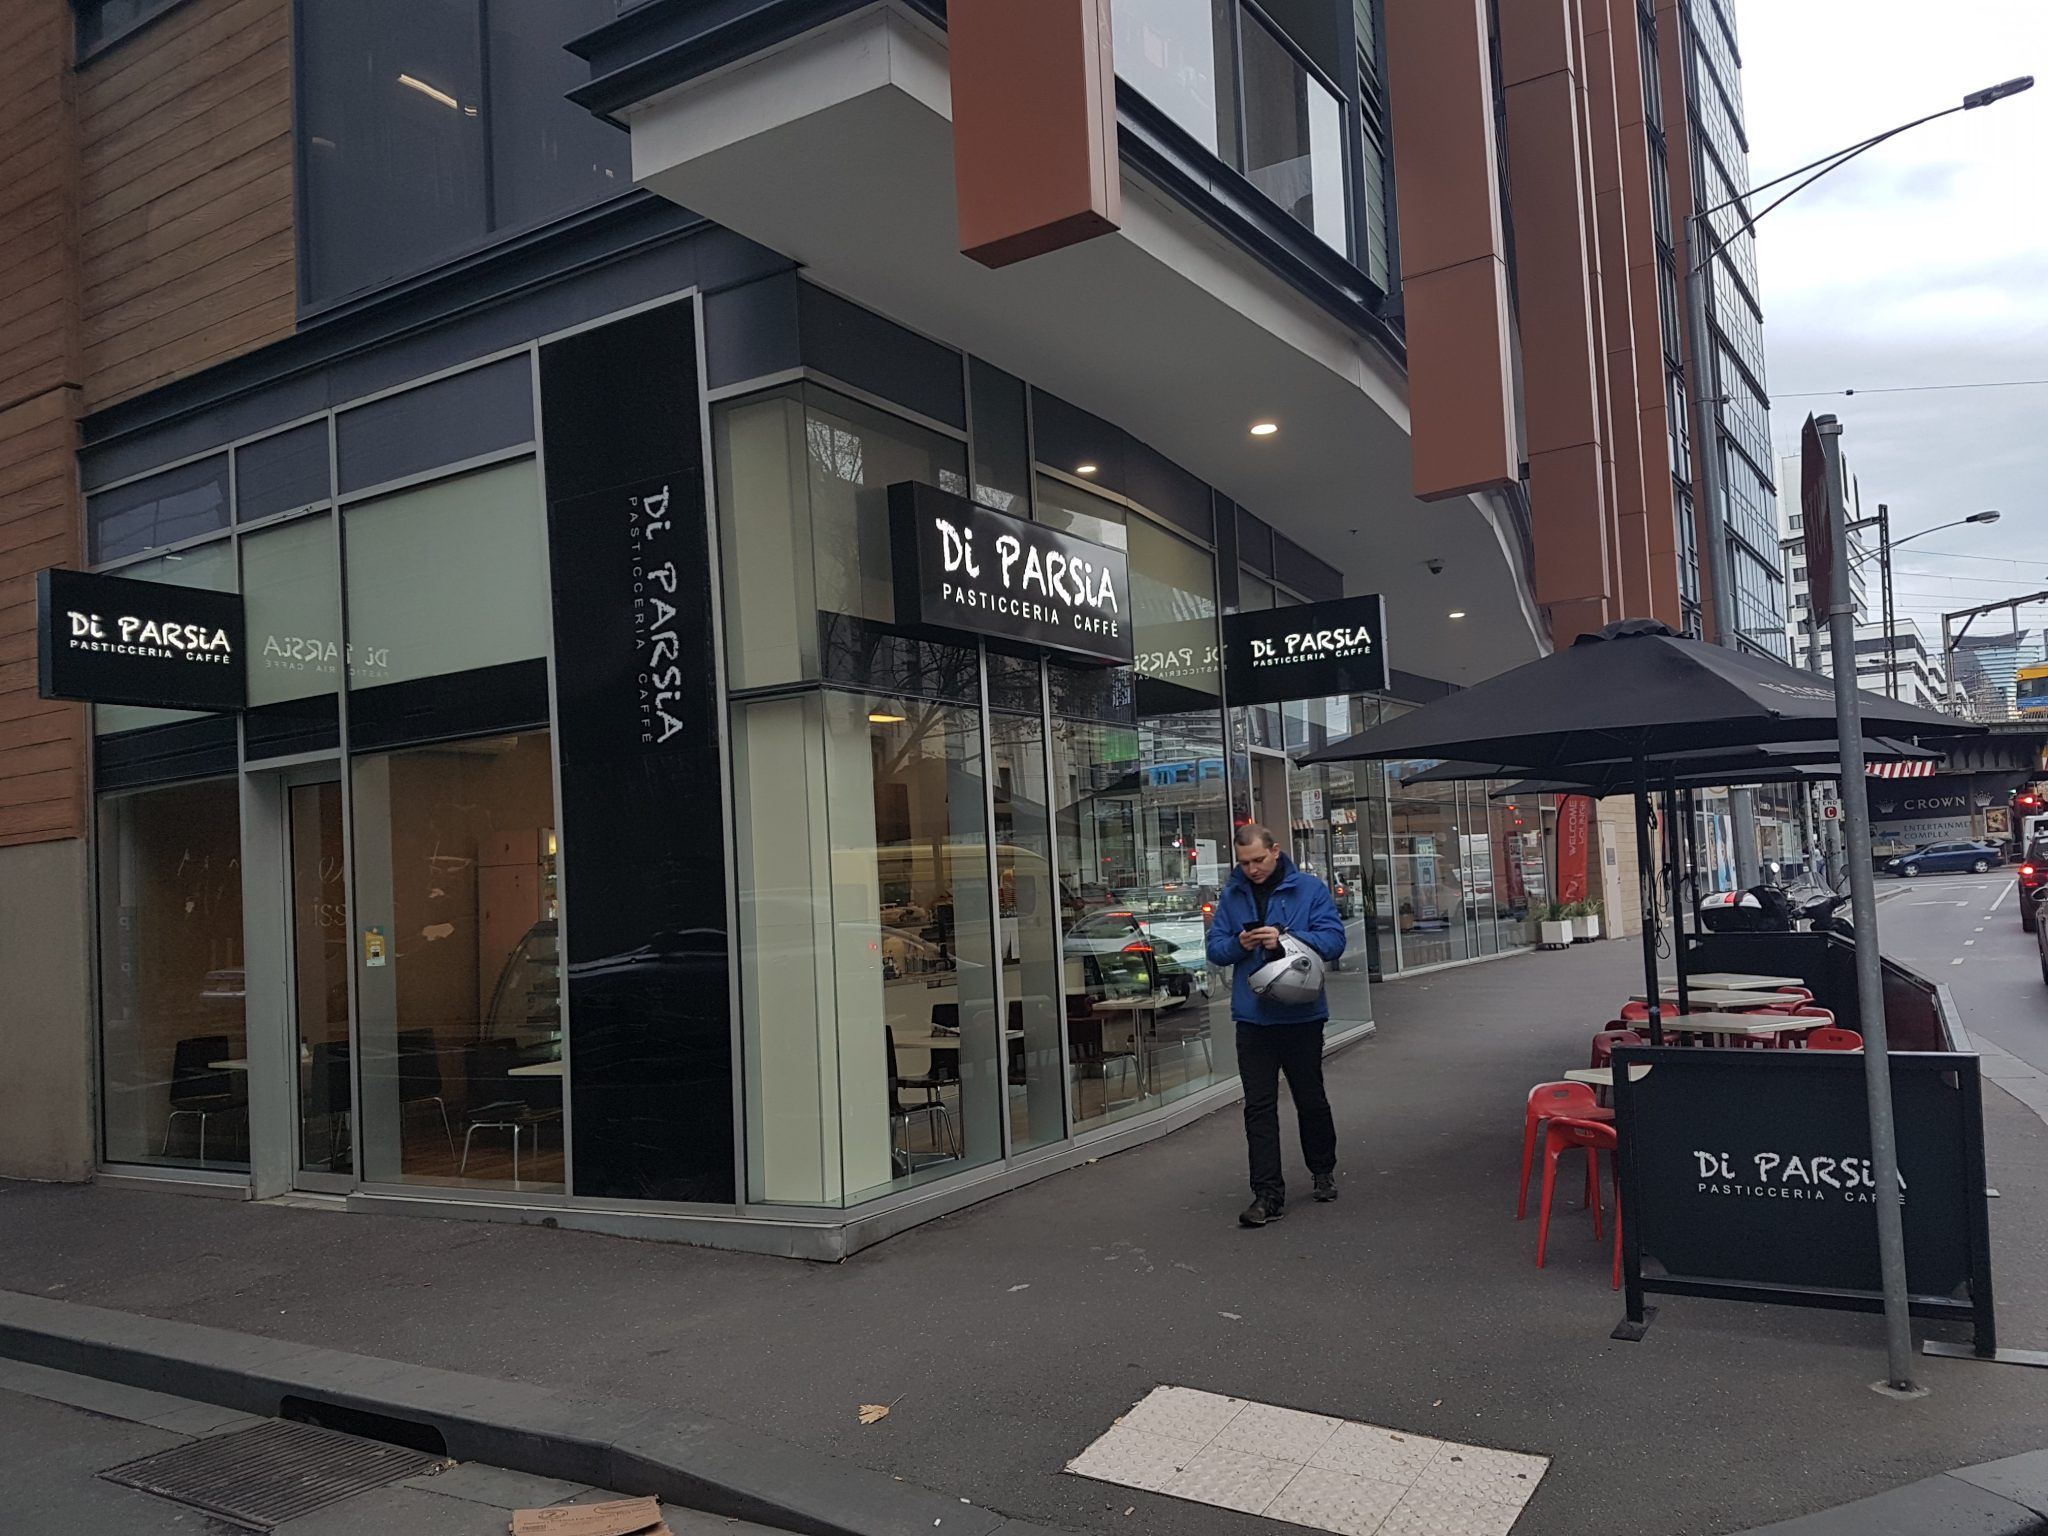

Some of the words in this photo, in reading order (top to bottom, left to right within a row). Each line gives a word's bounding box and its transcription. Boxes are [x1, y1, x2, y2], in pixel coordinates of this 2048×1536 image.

[643, 485, 671, 540] Di
[935, 518, 980, 578] Di
[628, 496, 646, 650] PASTICCERIA
[943, 583, 1060, 624] PASTICCERIA
[1074, 614, 1119, 638] CAFFÈ
[67, 611, 105, 638] Di
[70, 639, 173, 659] PASTICCERIA
[186, 651, 230, 664] CAFFÈ
[1250, 638, 1275, 658] Di
[1253, 652, 1326, 668] PASTICCERIA
[1904, 796, 1966, 811] CROWN
[1904, 820, 1975, 832] ENTERTAINME
[1904, 832, 1950, 840] COMPLEX
[1694, 1150, 1736, 1179] Di
[1698, 1183, 1824, 1201] PASTICCERIA
